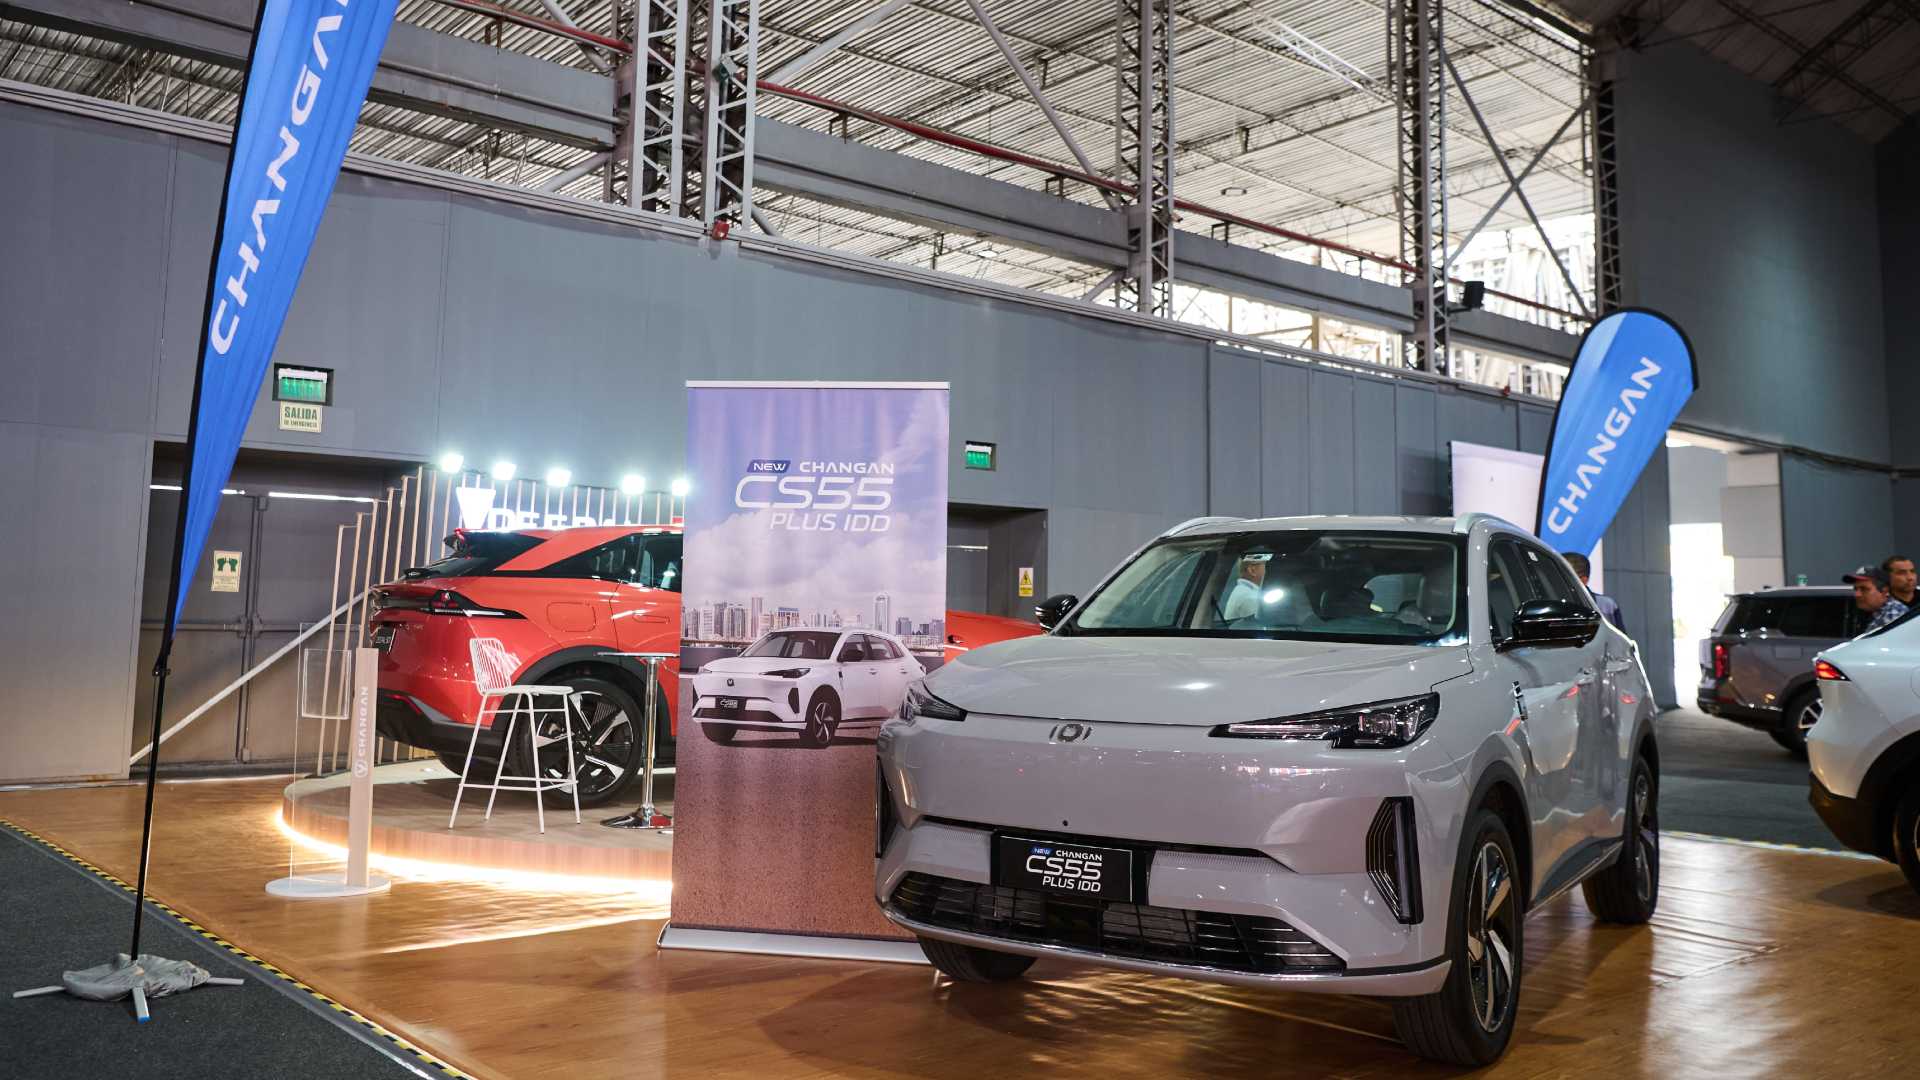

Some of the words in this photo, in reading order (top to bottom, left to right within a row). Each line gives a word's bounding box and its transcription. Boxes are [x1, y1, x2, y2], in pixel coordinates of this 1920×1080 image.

[211, 0, 349, 354] CHANGA
[284, 406, 318, 420] SALIDA
[1547, 357, 1662, 534] CHANGAN
[753, 462, 786, 472] NEW
[799, 461, 894, 474] CHANGAN
[735, 475, 894, 511] CS55
[770, 512, 837, 531] PLUS
[843, 513, 891, 532] IDD
[358, 686, 369, 757] CHANGAN
[1055, 850, 1103, 861] CHANGAN
[1026, 854, 1103, 881] CS55
[1042, 876, 1075, 890] PLUS
[1077, 881, 1102, 892] IDD
